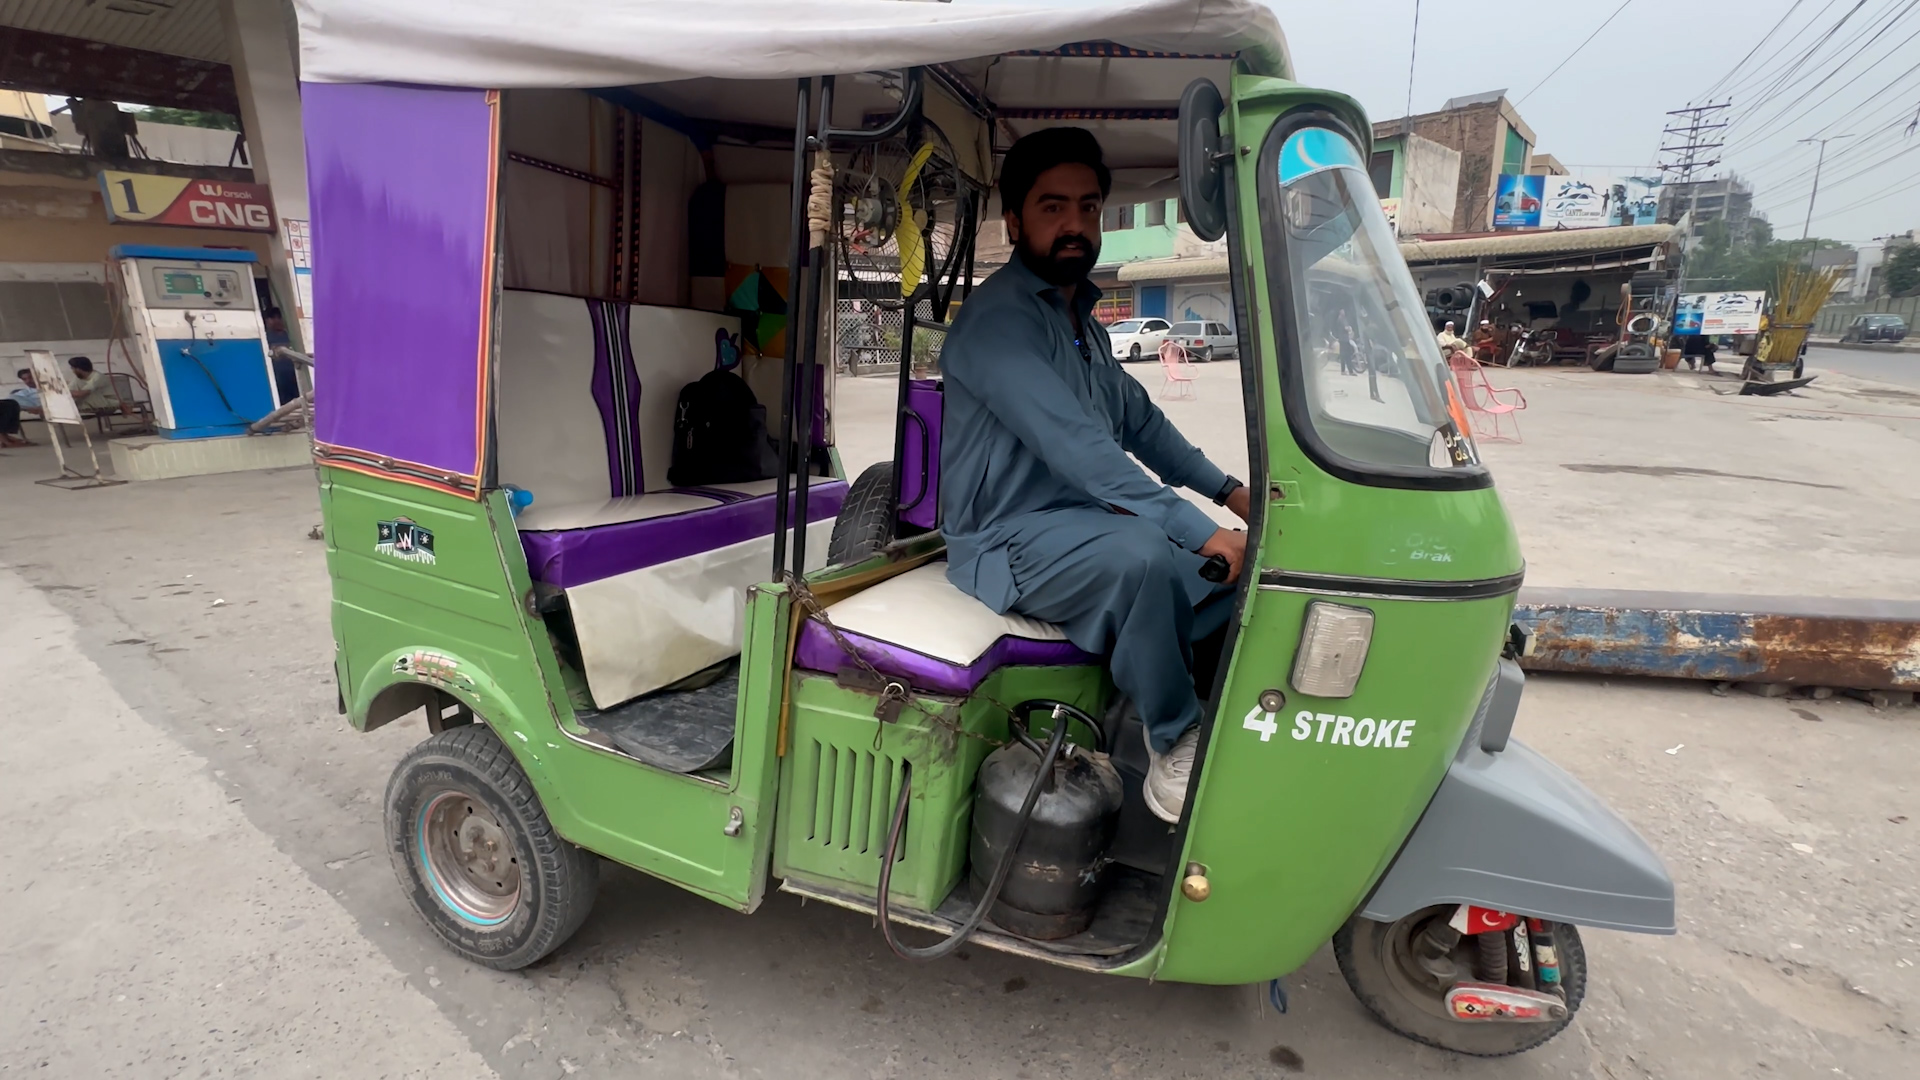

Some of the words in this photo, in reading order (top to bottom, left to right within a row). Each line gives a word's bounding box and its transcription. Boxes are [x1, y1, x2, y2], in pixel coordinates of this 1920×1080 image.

[115, 178, 146, 214] 1
[199, 184, 252, 199] Warsak
[189, 200, 271, 227] CNG
[1243, 704, 1278, 742] 4
[1291, 710, 1416, 748] STROKE
